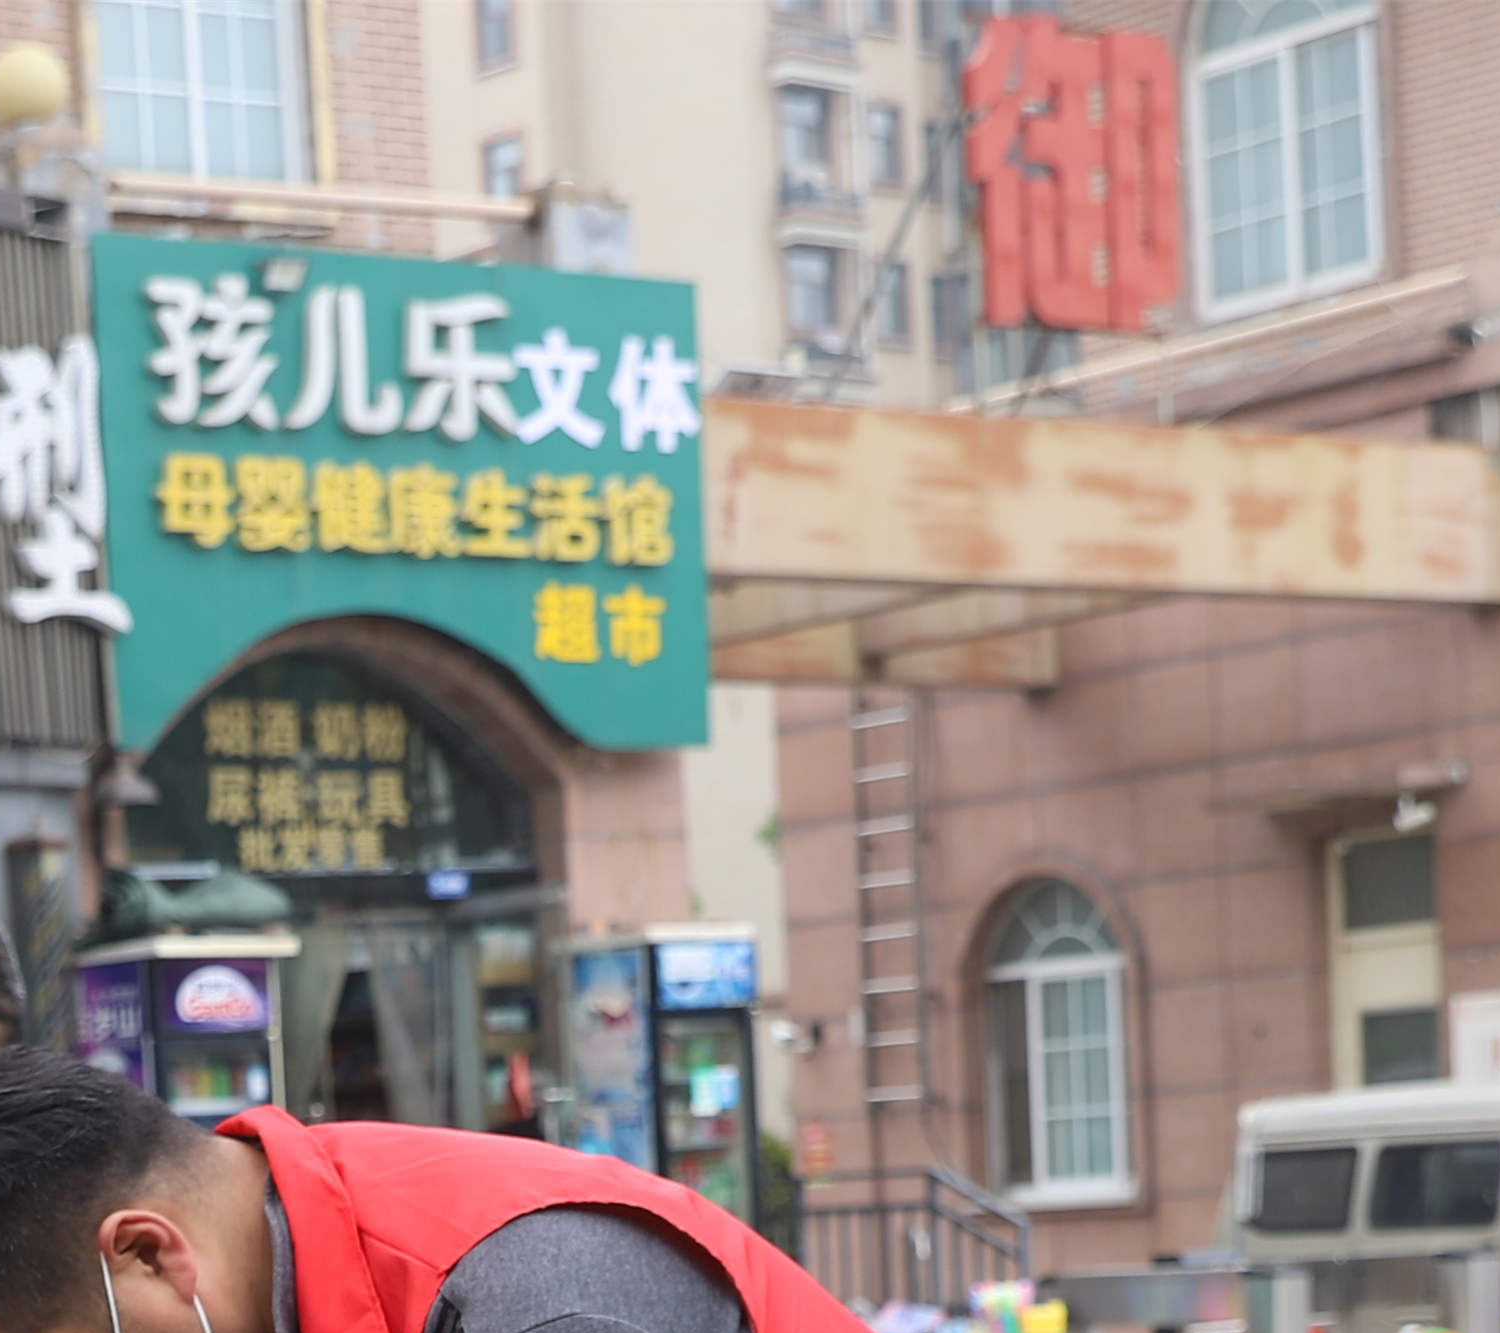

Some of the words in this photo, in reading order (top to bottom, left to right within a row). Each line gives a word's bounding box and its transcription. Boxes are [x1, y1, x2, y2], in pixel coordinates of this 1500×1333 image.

[156, 450, 675, 568] 母婴健康生活馆
[532, 580, 668, 667] 超市
